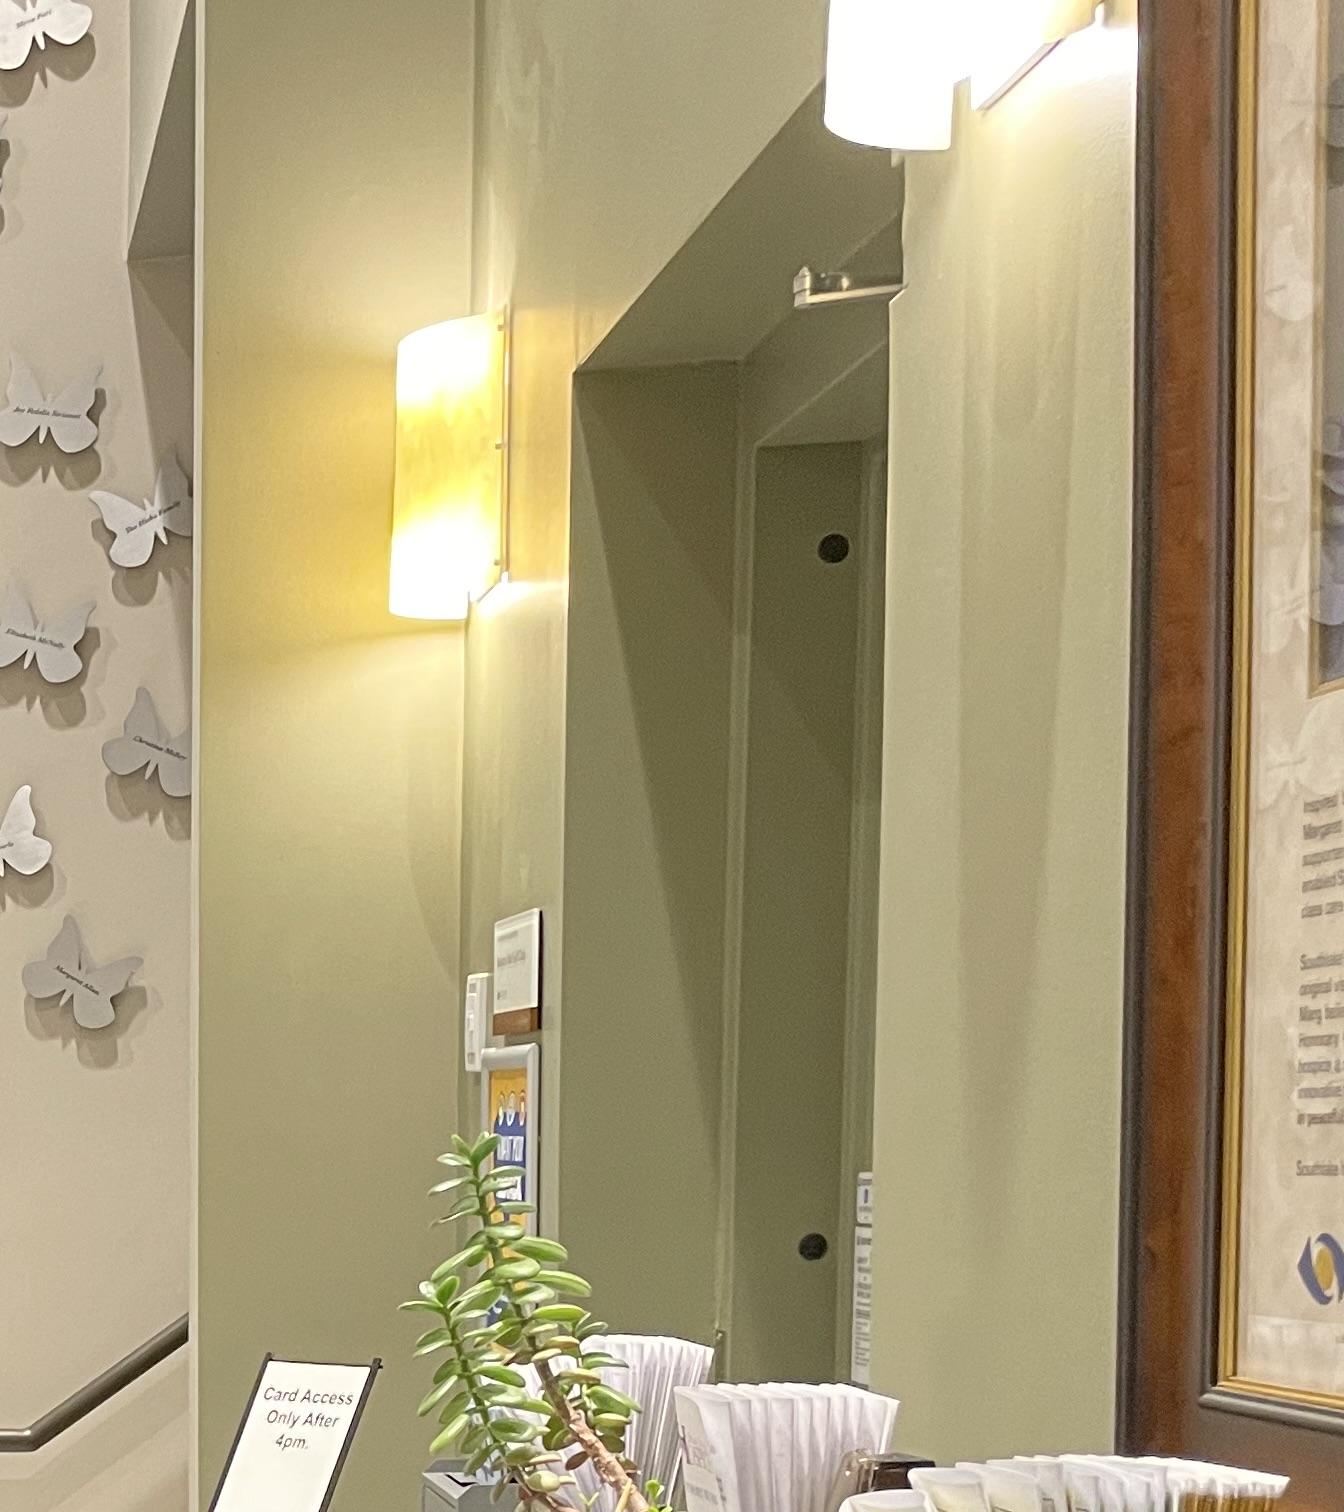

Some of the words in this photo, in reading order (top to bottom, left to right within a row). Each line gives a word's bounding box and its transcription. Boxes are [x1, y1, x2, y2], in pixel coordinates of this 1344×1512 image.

[263, 1387, 299, 1402] Card
[300, 1389, 354, 1405] Access
[266, 1410, 300, 1428] Only
[302, 1413, 340, 1428] After
[275, 1434, 309, 1451] 4pm.
